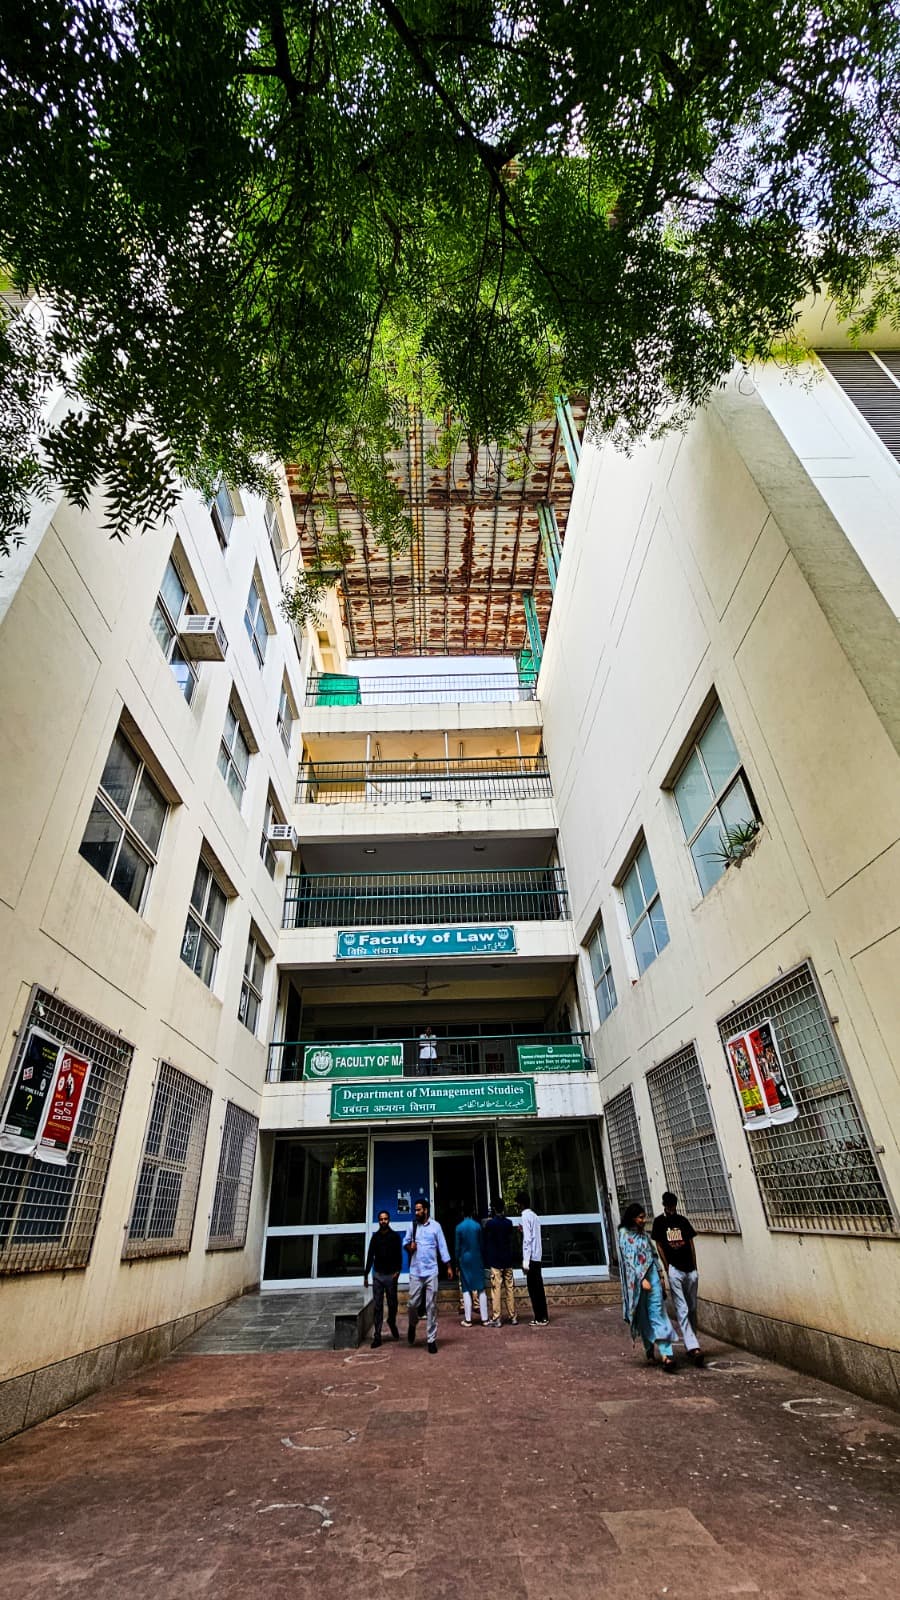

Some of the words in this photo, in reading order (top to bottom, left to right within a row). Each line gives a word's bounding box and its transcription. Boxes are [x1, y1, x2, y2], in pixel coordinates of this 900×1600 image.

[359, 934, 426, 946] Faculty
[432, 931, 451, 943] of
[456, 931, 495, 943] Law
[335, 1056, 376, 1068] FACULTY
[377, 1055, 390, 1066] OF
[343, 1089, 404, 1102] Department
[406, 1087, 418, 1098] of
[419, 1086, 485, 1099] Management
[487, 1084, 524, 1095] Studies
[373, 1103, 405, 1113] अध्ययन
[410, 1101, 436, 1111] विभाग
